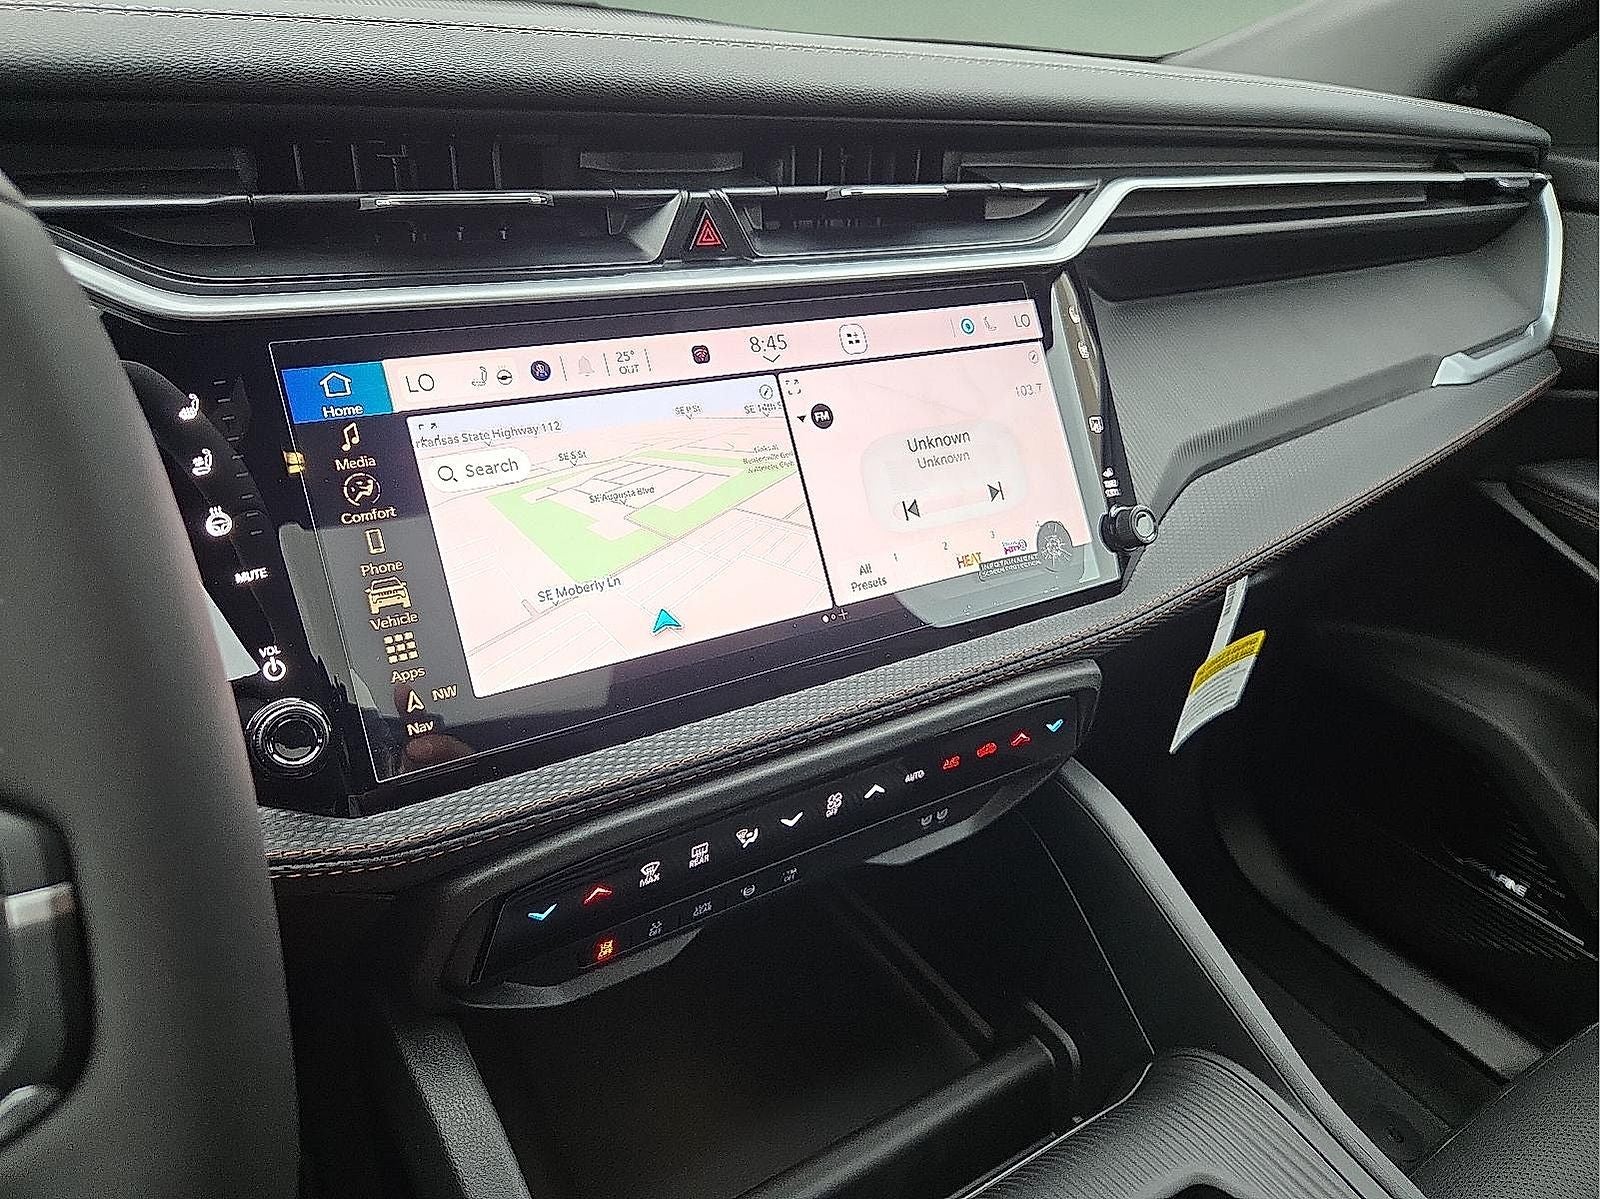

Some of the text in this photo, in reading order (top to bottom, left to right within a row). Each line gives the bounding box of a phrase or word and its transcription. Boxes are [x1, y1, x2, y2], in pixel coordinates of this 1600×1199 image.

[1013, 313, 1031, 328] LO
[749, 334, 788, 353] 8:45
[615, 350, 635, 363] 25°
[618, 363, 640, 375] OUT
[405, 373, 435, 394] LO
[1014, 383, 1042, 397] 103.7
[322, 402, 364, 419] Home
[813, 410, 831, 423] FM
[461, 430, 491, 444] State
[492, 424, 540, 441] Highway
[541, 420, 562, 433] 112
[906, 430, 971, 453] Unknown
[335, 454, 377, 471] Media
[465, 457, 519, 479] Search
[917, 451, 971, 470] Unknown
[341, 505, 397, 525] Comfort
[360, 559, 404, 577] Phone
[956, 551, 982, 569] HEAT
[234, 567, 269, 584] MUTE
[859, 562, 873, 576] All
[537, 576, 622, 603] SE Moberly Ln
[850, 575, 888, 593] Presets
[369, 611, 419, 632] Vehicle
[258, 644, 281, 659] VOL
[391, 666, 427, 684] Apps
[431, 684, 458, 702] NW
[406, 720, 434, 736] Nav
[904, 768, 925, 783] AUTO
[689, 853, 710, 869] REAR
[639, 873, 661, 888] MAX
